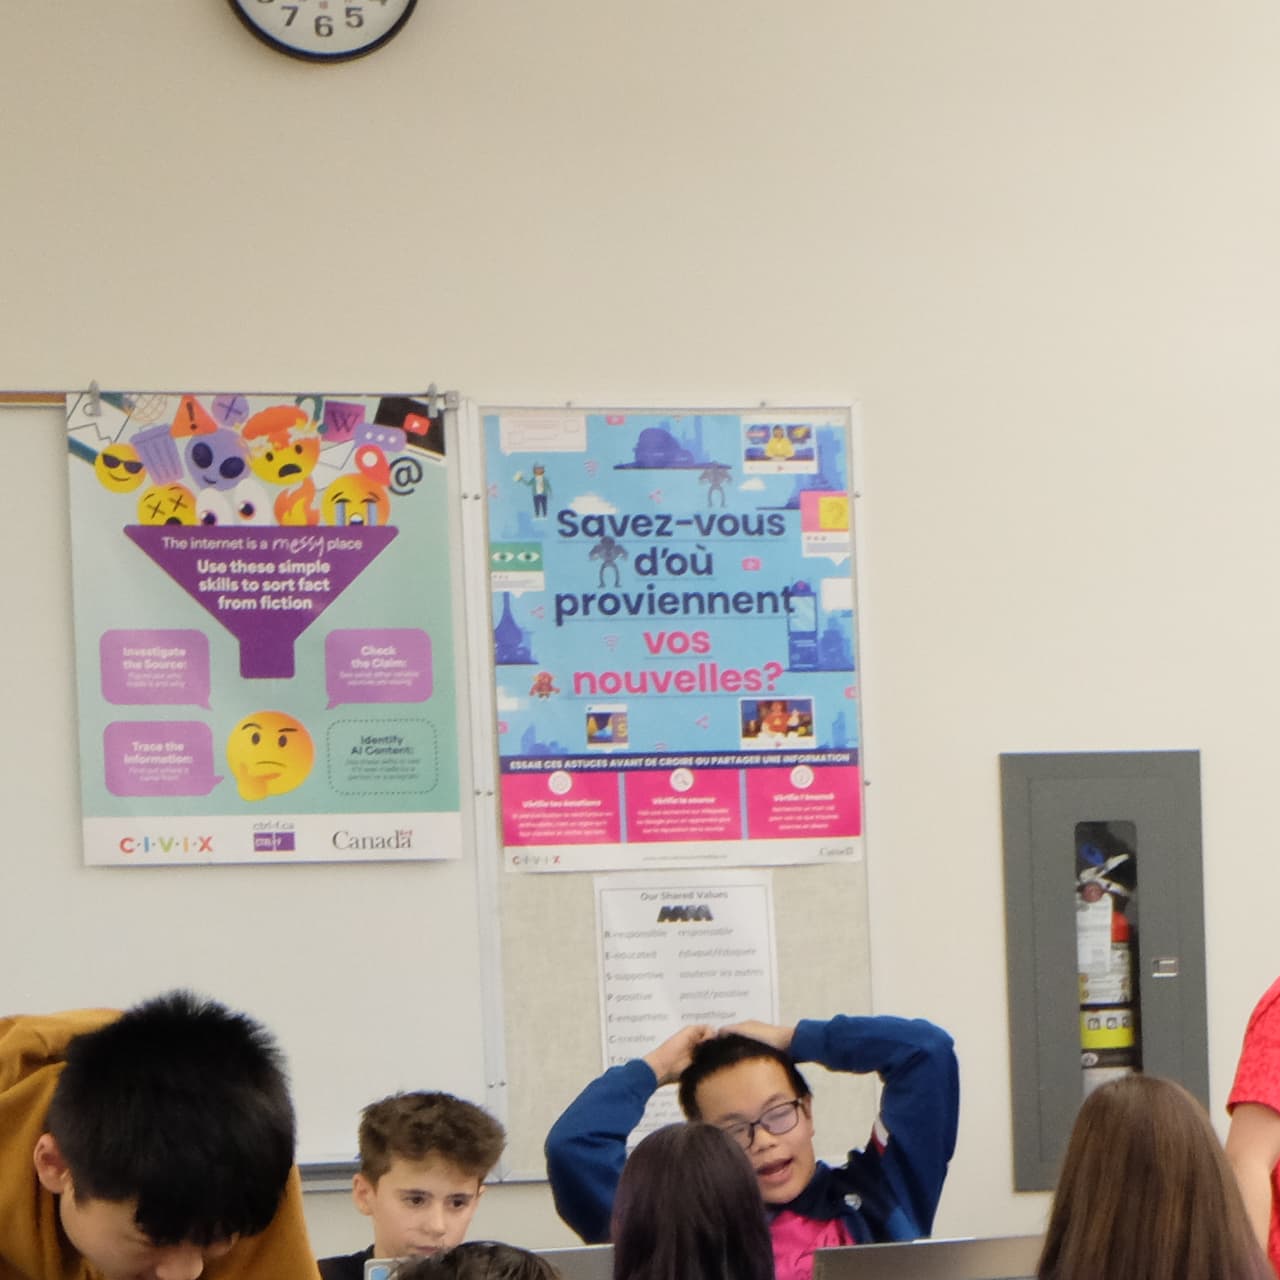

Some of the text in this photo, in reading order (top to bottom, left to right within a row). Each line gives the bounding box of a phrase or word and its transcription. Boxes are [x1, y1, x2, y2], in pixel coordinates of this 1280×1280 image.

[557, 509, 786, 538] Savez-vous
[161, 536, 363, 557] The internet is a messy place
[197, 559, 331, 576] Use these simple
[199, 578, 330, 592] skills to sort fact
[218, 596, 312, 610] from fiction
[555, 584, 796, 627] proviennent
[643, 631, 710, 655] vos
[123, 647, 186, 658] Investigate
[361, 646, 397, 656] Check
[123, 660, 142, 669] the
[351, 659, 370, 669] the
[574, 661, 784, 694] nouvelles?
[132, 741, 184, 752] Trace the
[361, 735, 404, 746] Identify
[510, 760, 543, 770] ESSAIE
[544, 760, 562, 769] CES
[564, 759, 608, 769] ASTUCES
[609, 758, 644, 768] AVANT
[645, 758, 657, 767] DE
[659, 756, 694, 767] CROIRE
[711, 755, 761, 766] PARTAGER
[763, 755, 780, 764] UNE
[782, 753, 850, 764] INFORMATION
[333, 829, 413, 850] Canada
[641, 890, 728, 901] Our Shared Values
